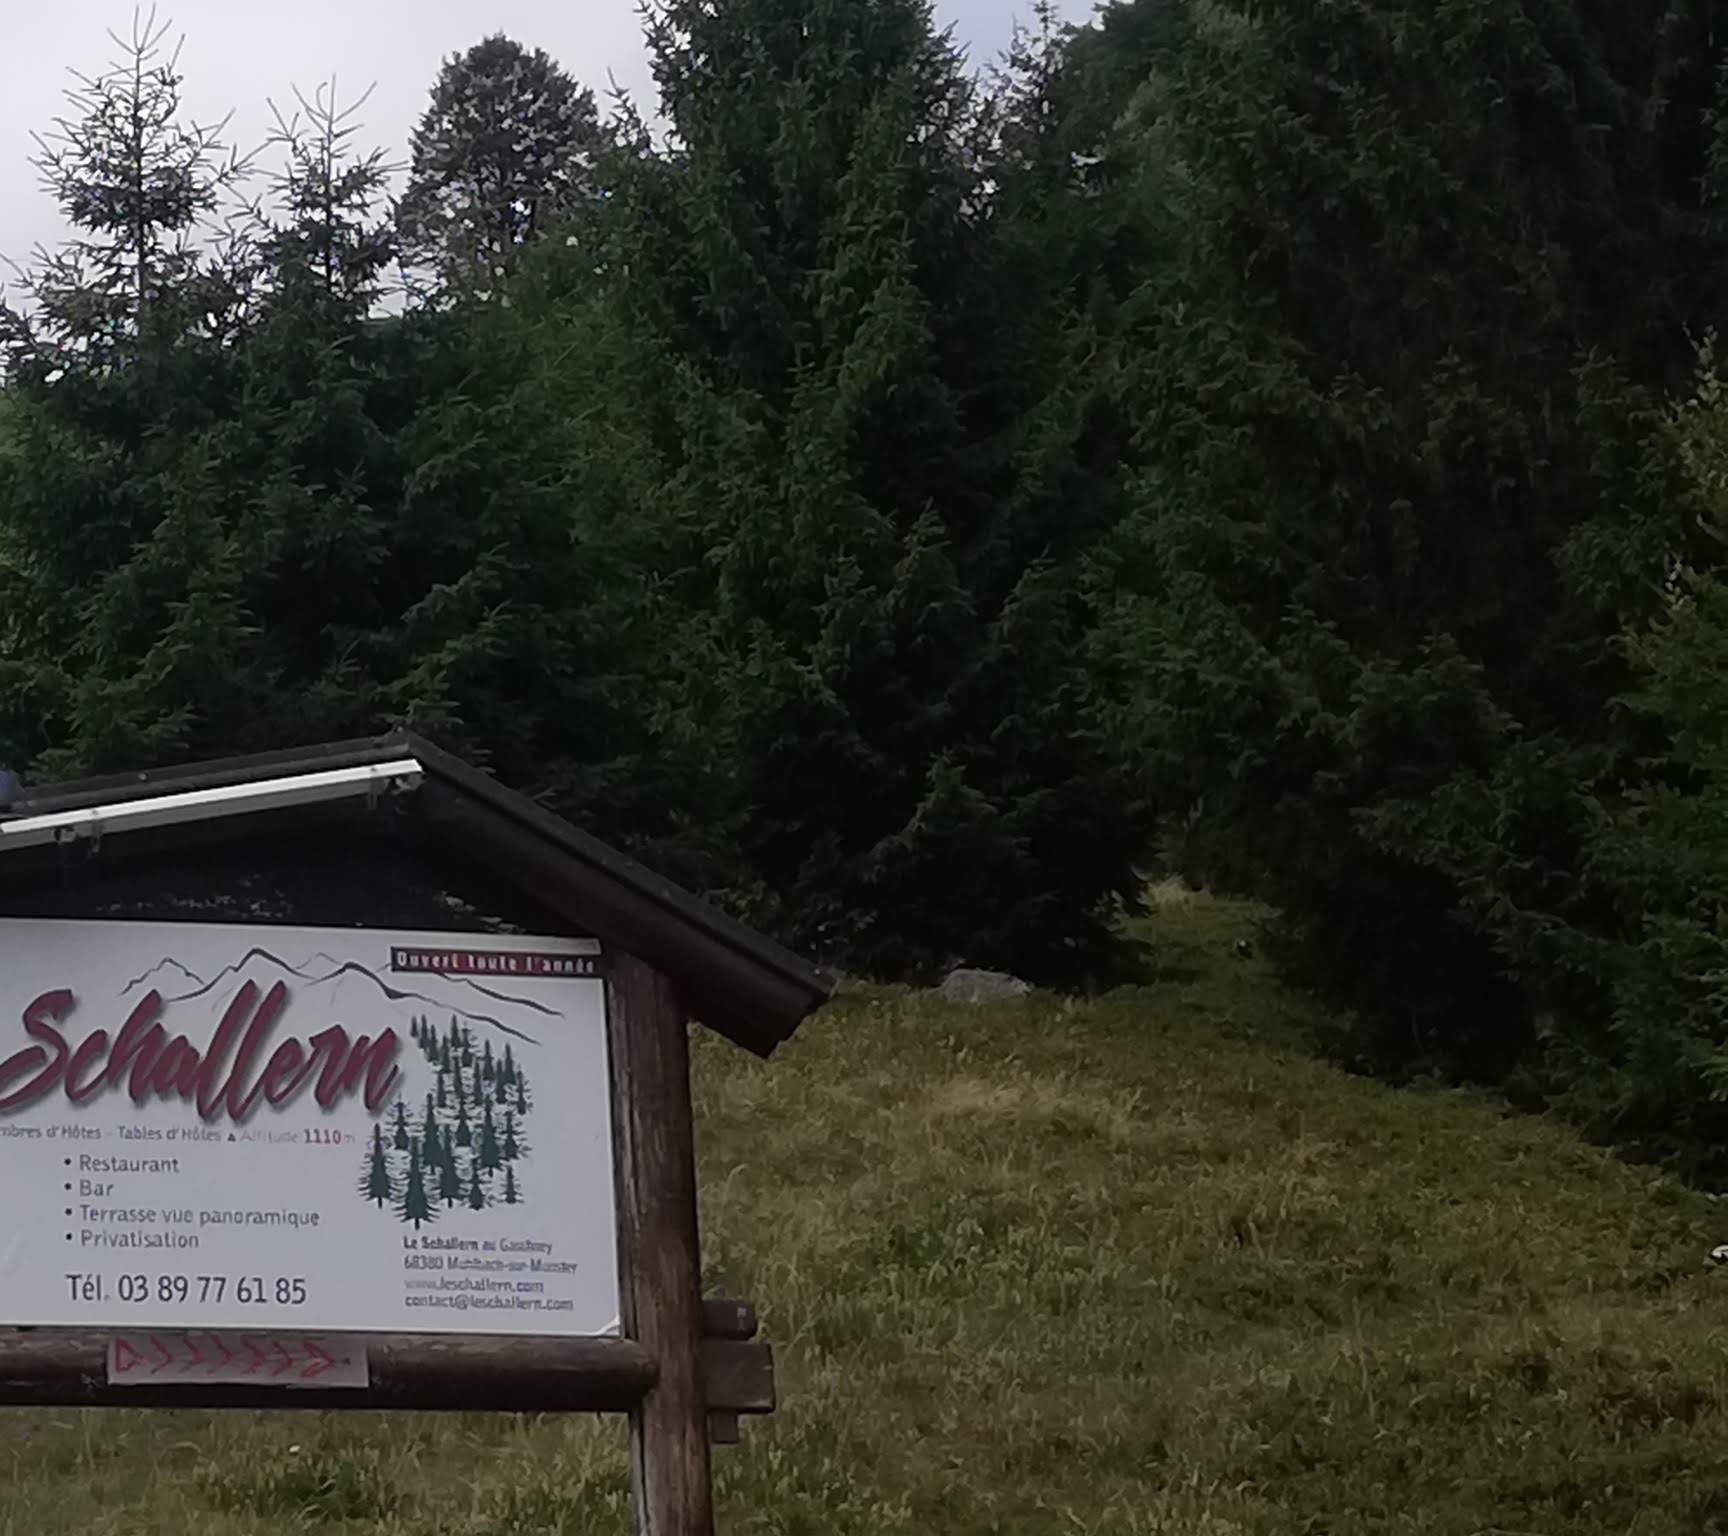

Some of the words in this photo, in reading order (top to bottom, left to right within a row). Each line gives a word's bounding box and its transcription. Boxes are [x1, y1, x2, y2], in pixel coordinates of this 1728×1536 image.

[397, 951, 458, 968] Ouvert
[469, 954, 517, 970] toute
[118, 1125, 163, 1140] Tables
[79, 1154, 180, 1173] Restaurant
[79, 1179, 114, 1196] Bar
[80, 1204, 157, 1223] Terrasse
[162, 1209, 193, 1224] vue
[200, 1209, 320, 1228] panoramique
[81, 1229, 199, 1249] Privatisation
[403, 1235, 418, 1250] Le
[421, 1236, 479, 1251] Schallern
[65, 1274, 111, 1302] Tél.
[118, 1275, 149, 1303] 03
[158, 1275, 189, 1303] 89
[197, 1276, 227, 1303] 77
[237, 1276, 268, 1304] 61
[276, 1278, 306, 1305] 85
[404, 1294, 574, 1311] contact@leschallern.com
